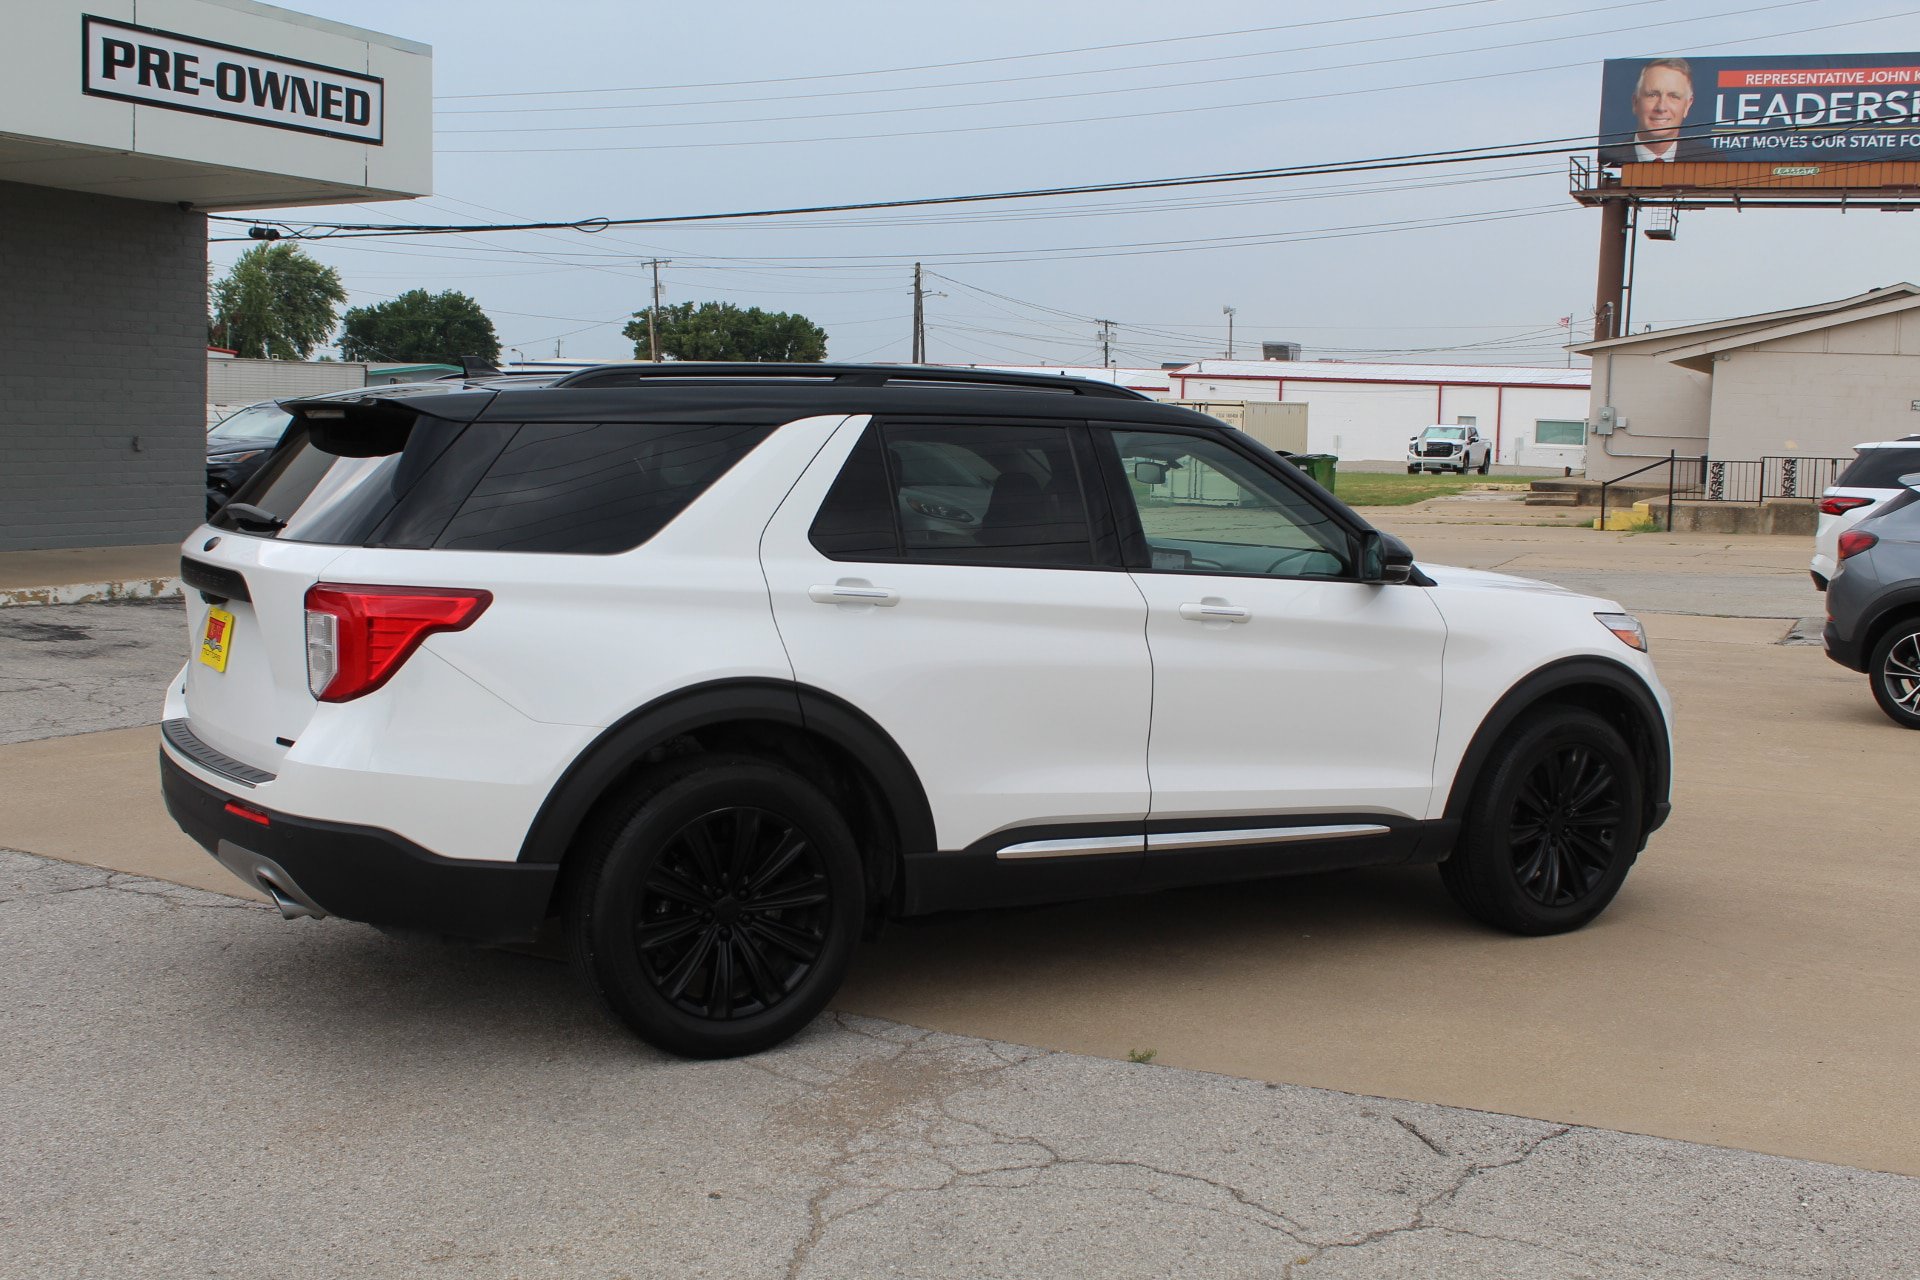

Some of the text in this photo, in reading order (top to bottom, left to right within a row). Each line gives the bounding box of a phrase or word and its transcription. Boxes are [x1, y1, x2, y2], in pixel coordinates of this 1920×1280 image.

[102, 37, 370, 126] PRE-OWNED
[1745, 72, 1864, 85] REPRESENTATIVE
[1867, 71, 1910, 83] JOHN
[1711, 136, 1749, 148] THAT
[1752, 135, 1808, 148] MOVES
[1812, 135, 1846, 148] OUR
[1850, 134, 1896, 147] STATE
